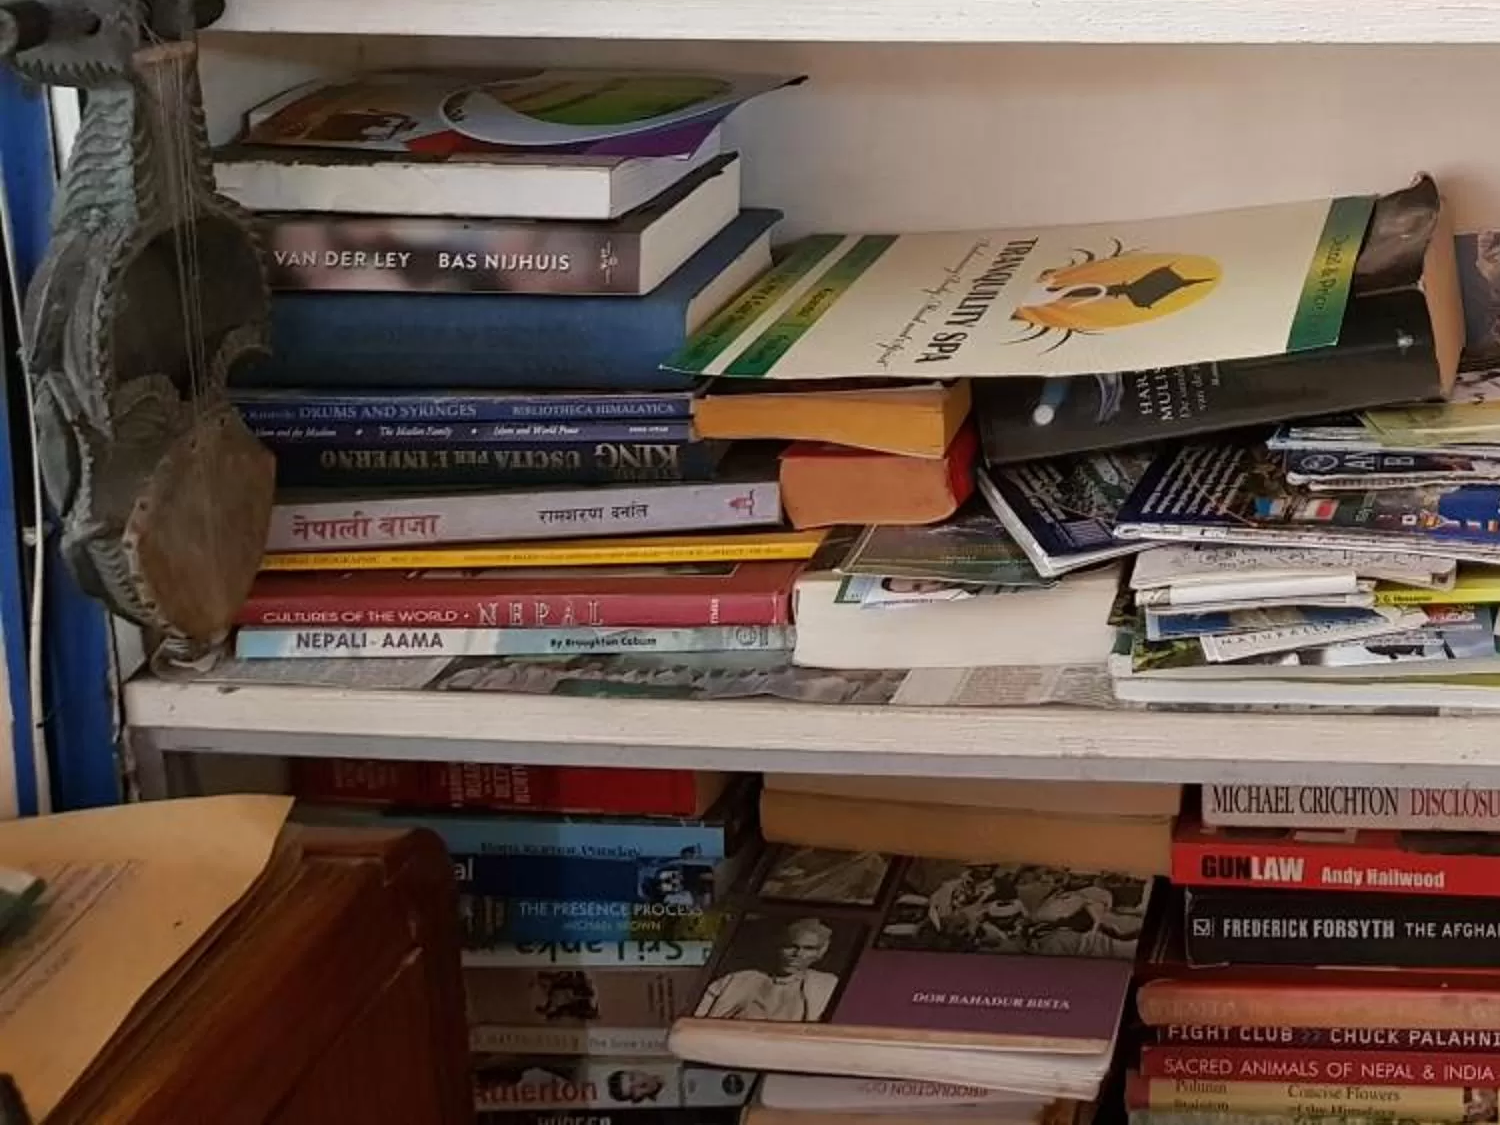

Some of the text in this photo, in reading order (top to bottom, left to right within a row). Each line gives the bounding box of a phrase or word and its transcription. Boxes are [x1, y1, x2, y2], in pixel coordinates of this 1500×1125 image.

[273, 249, 571, 271] VAN DER LEY BAS NIJHUIS
[944, 236, 1039, 328] TRANQUILITY
[915, 331, 963, 364] SPA
[299, 404, 398, 419] DRUMS AND
[319, 448, 582, 468] USCITA L'INFERNO
[594, 442, 680, 470] KING
[293, 511, 442, 540] नेपाली बाजा
[262, 610, 459, 623] CULTURES OF THE WORLD
[296, 632, 444, 651] NEPALI AAMA
[1210, 784, 1295, 816] MICHAEL
[1298, 784, 1399, 817] CRICHTON
[1321, 866, 1446, 889] Andy Hailwood
[519, 901, 630, 917] THE PRESENCE
[1222, 918, 1309, 941] FREDERICK
[1312, 918, 1396, 941] FORSYTH
[1404, 921, 1438, 939] THE
[947, 993, 1071, 1011] BAHADUR BISTA
[1167, 1025, 1231, 1041] FIGHT
[1238, 1027, 1294, 1043] CLUB
[1329, 1028, 1399, 1045] CHUCK
[1162, 1058, 1496, 1082] SACRED ANIMALS OF NEPAL & INDIA
[1287, 1083, 1402, 1102] Concise Flowers
